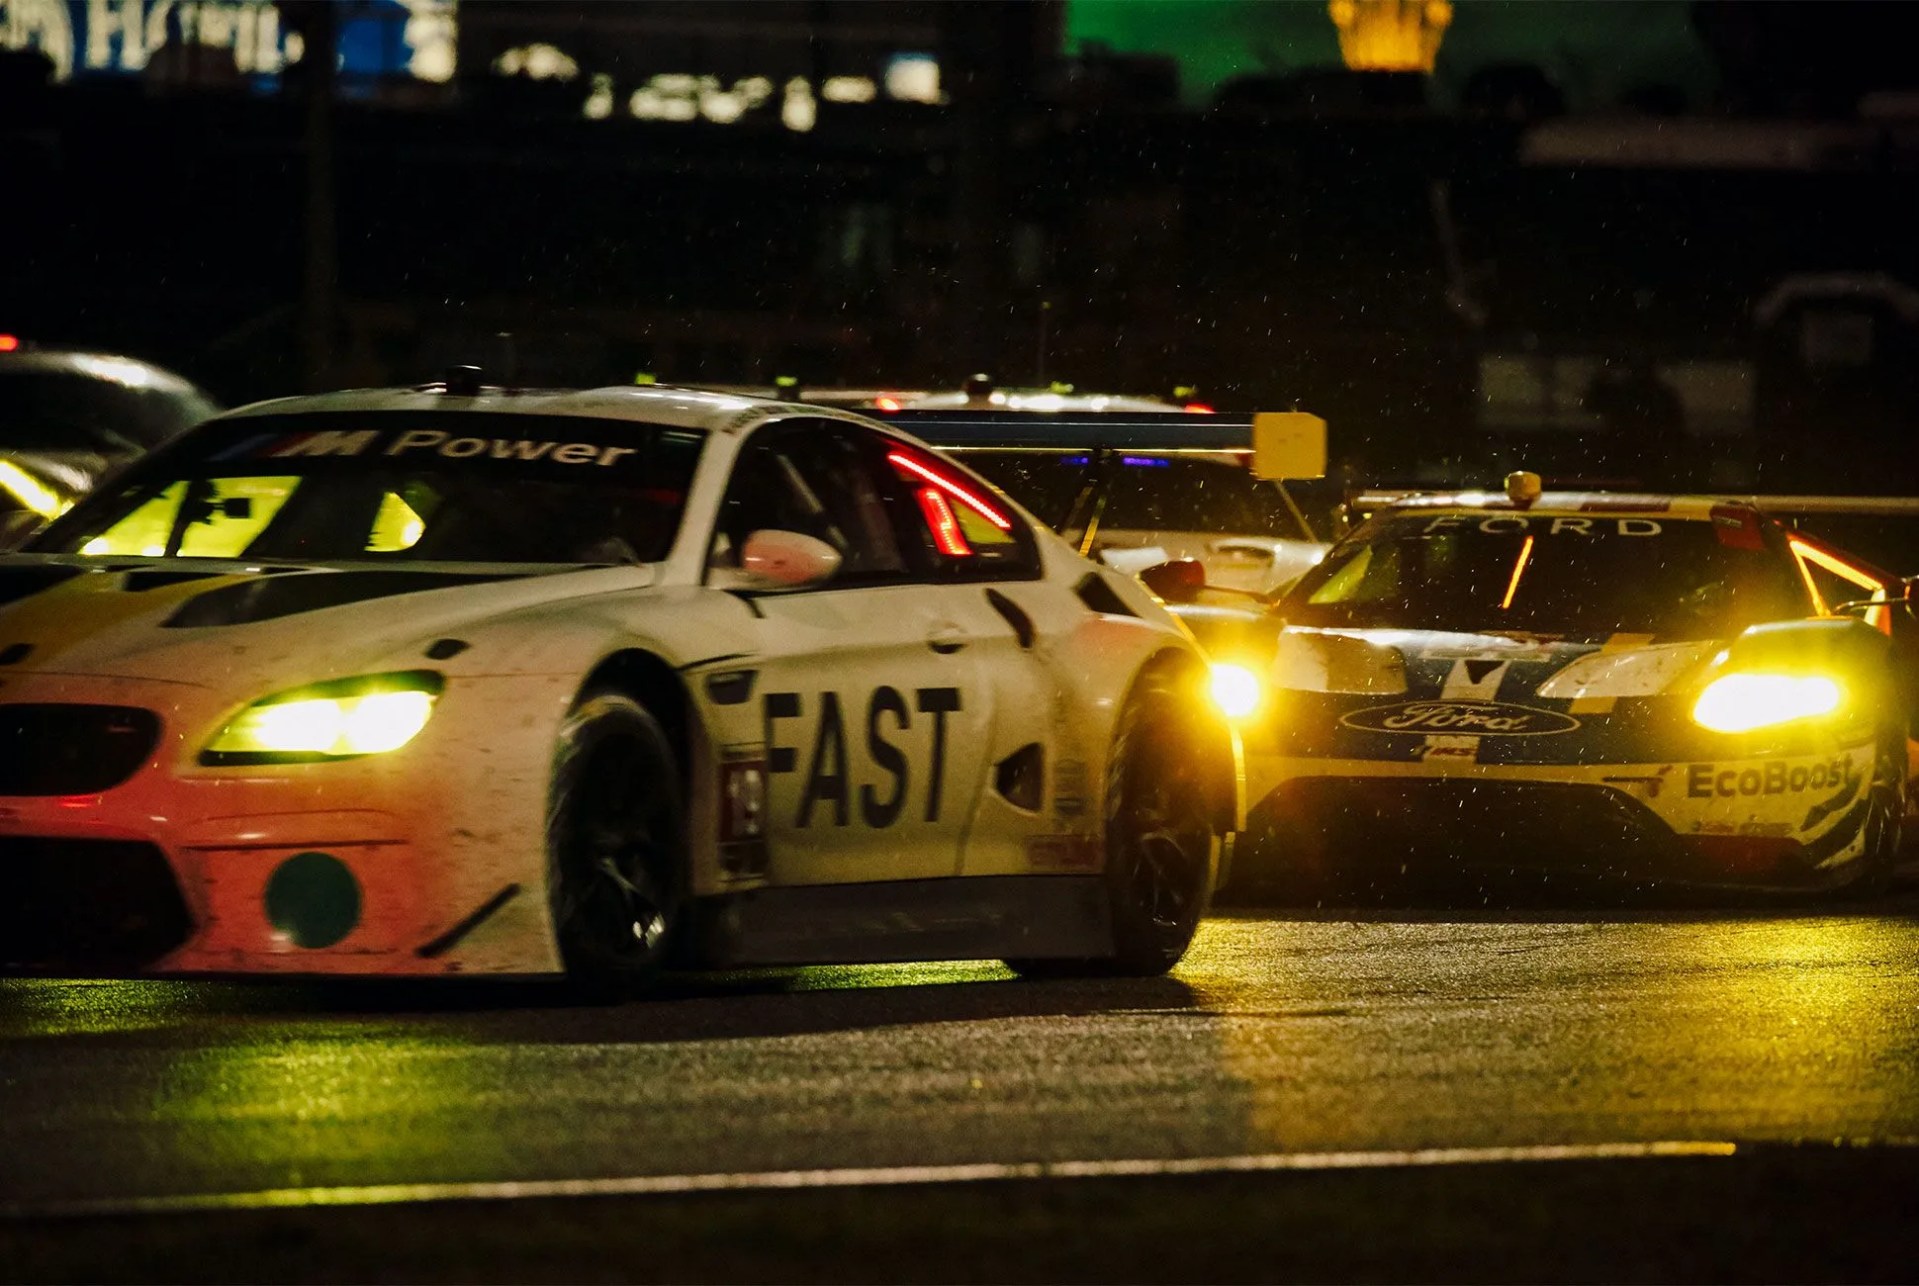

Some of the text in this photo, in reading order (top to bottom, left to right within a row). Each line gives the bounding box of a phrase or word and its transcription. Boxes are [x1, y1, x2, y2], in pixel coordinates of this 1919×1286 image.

[384, 429, 640, 467] Power
[1423, 515, 1662, 536] FORD
[1383, 702, 1533, 731] Ford
[763, 685, 963, 829] FAST
[1687, 755, 1853, 798] EcoBoost
